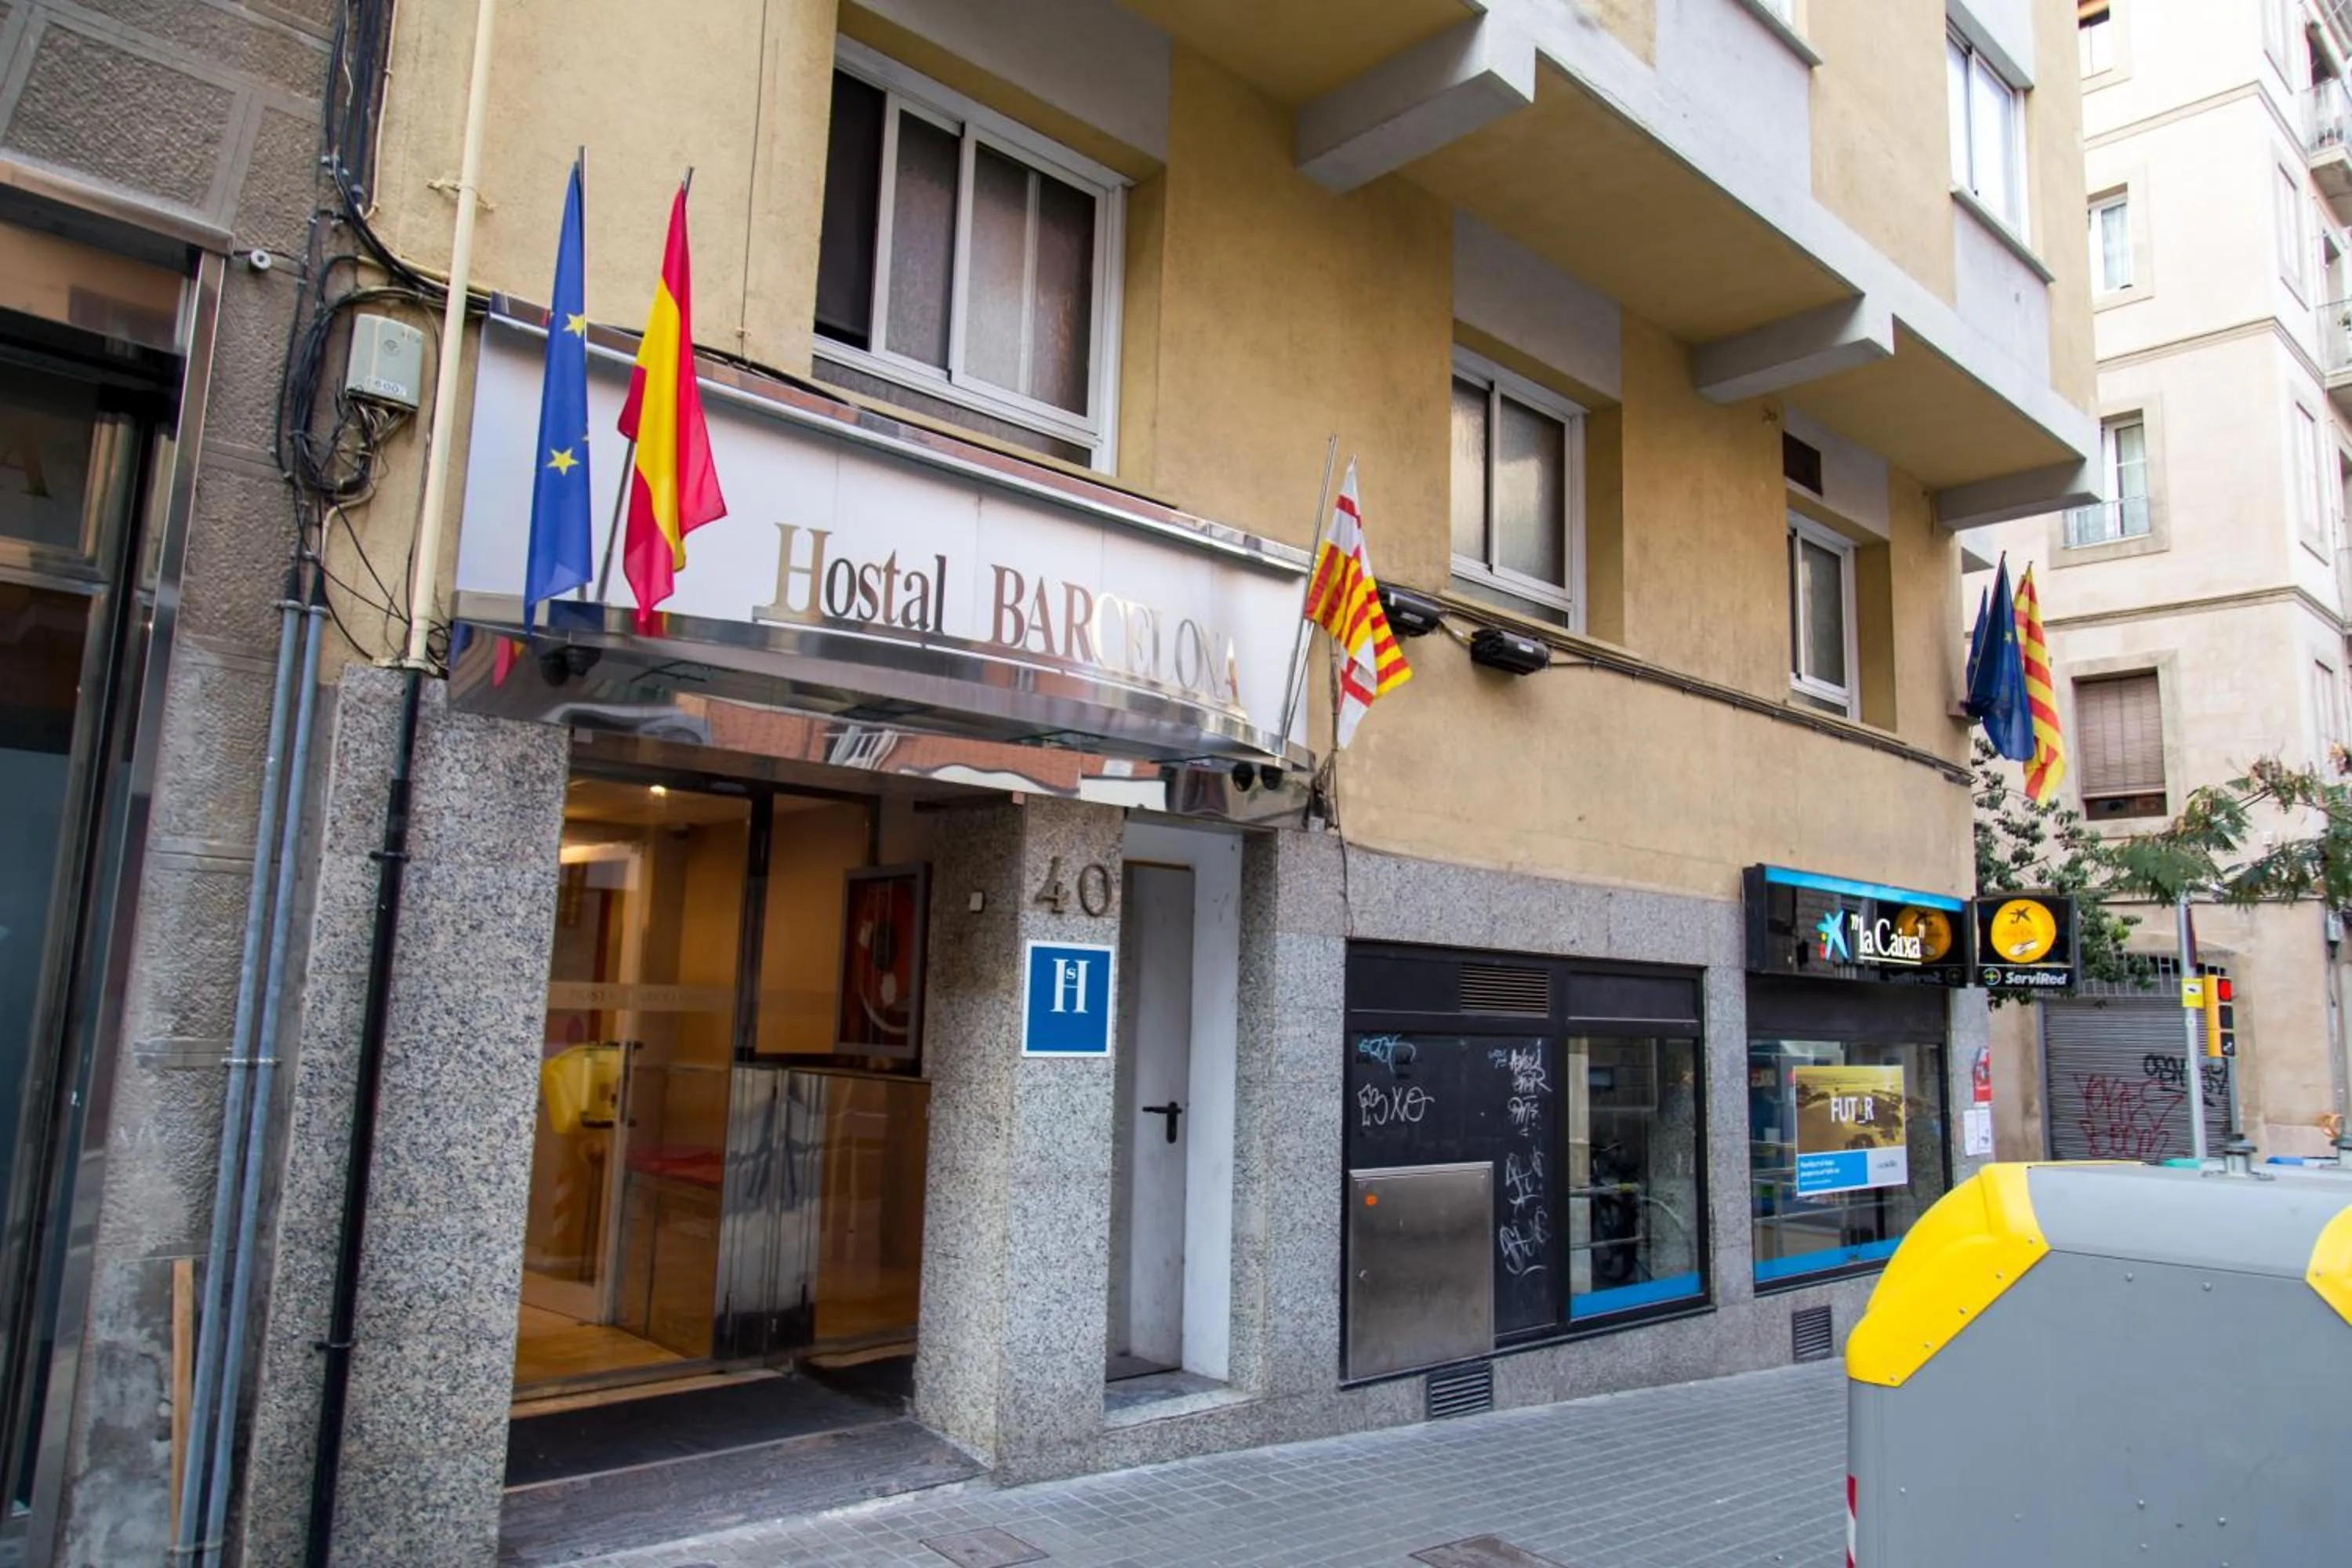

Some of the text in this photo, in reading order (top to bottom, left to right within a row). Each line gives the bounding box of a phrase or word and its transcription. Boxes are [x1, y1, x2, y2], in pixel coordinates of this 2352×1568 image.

[773, 521, 1244, 710] Hostal BARCELONA
[1034, 855, 1112, 918] 40
[1049, 957, 1091, 1014] H
[2005, 971, 2067, 986] ServiRed
